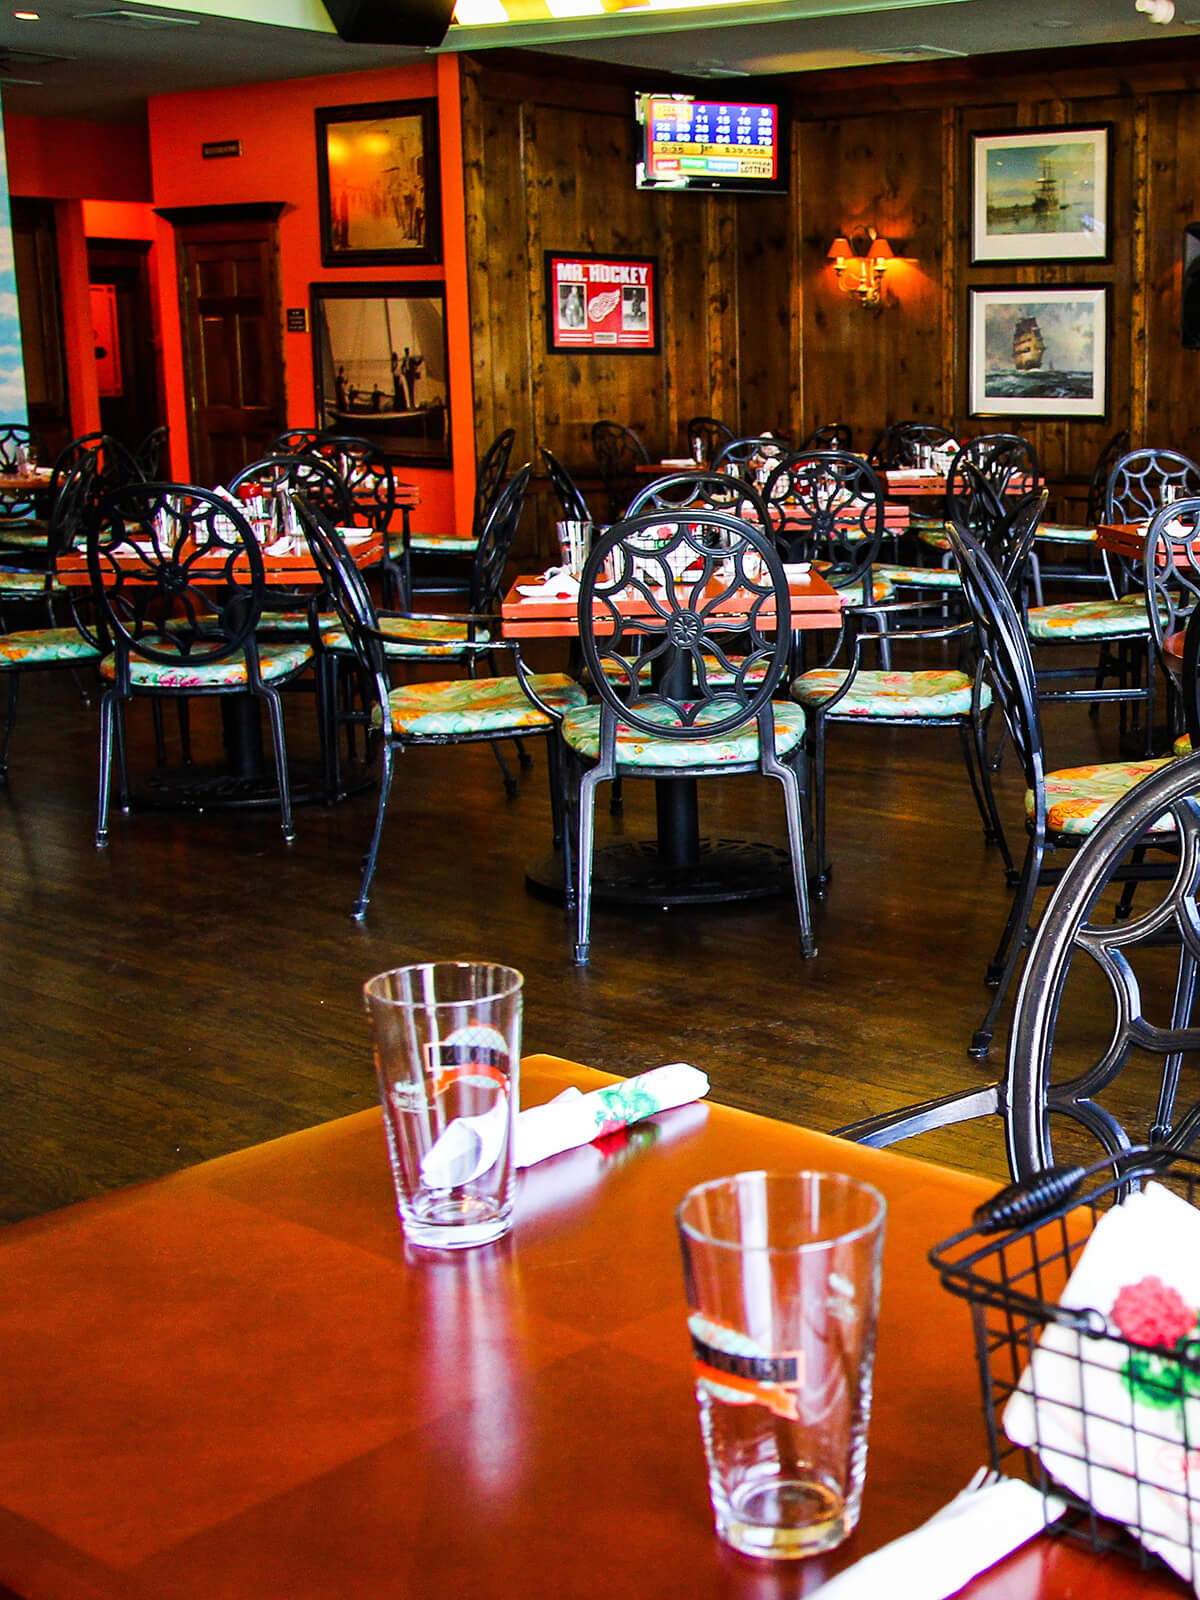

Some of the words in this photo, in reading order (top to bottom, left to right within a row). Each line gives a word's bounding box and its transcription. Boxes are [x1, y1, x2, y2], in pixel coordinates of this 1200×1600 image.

[696, 115, 708, 123] 11
[716, 135, 730, 143] 64
[737, 136, 751, 144] 74
[557, 263, 588, 282] MR.
[589, 264, 648, 284] HOCKEY
